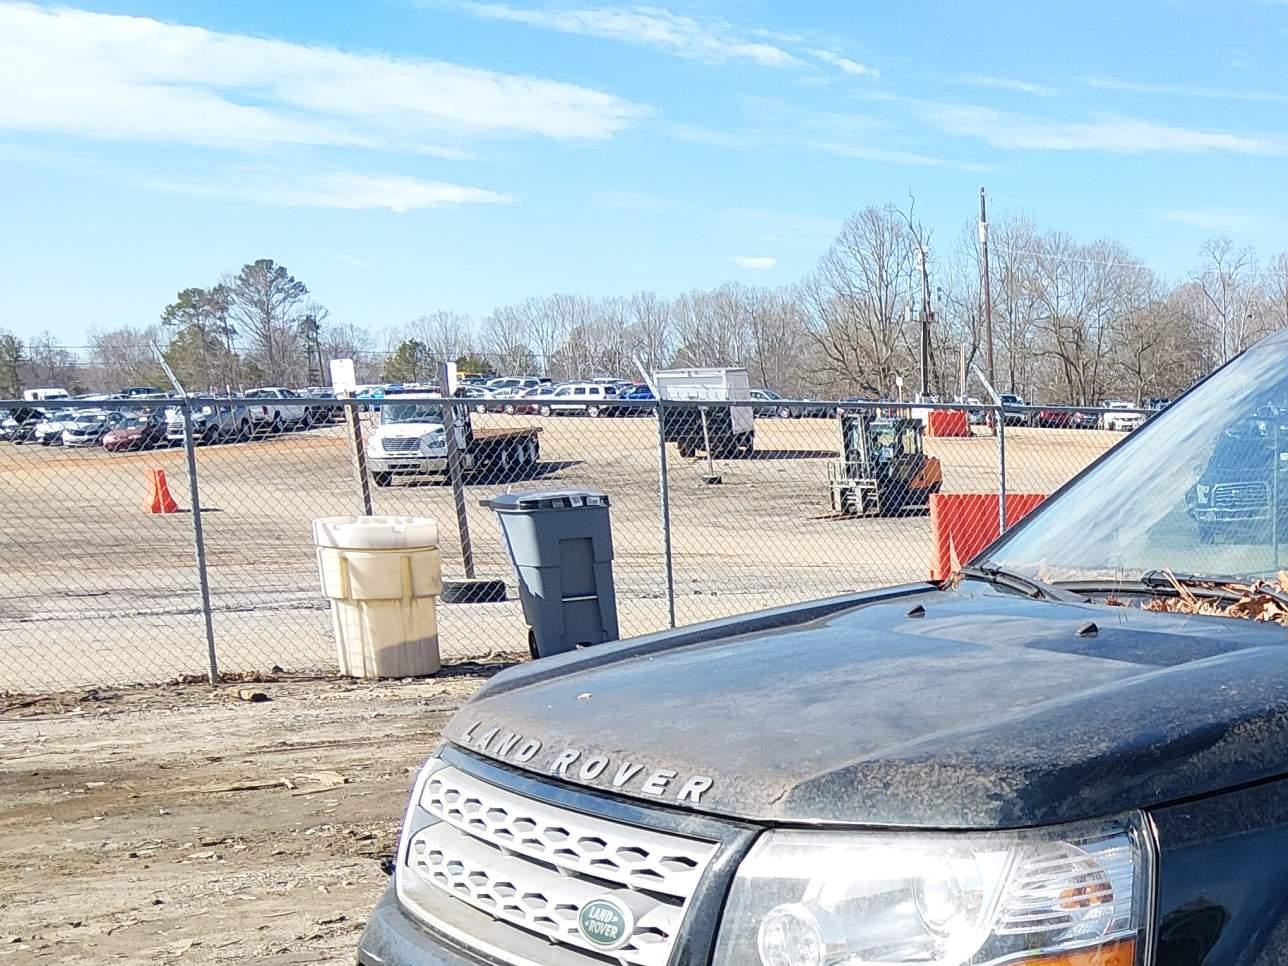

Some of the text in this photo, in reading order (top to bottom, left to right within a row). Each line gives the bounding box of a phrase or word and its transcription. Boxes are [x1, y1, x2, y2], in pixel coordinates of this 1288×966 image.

[464, 721, 714, 803] LAND ROVER
[589, 906, 614, 923] LAND
[588, 920, 619, 939] ROVER
